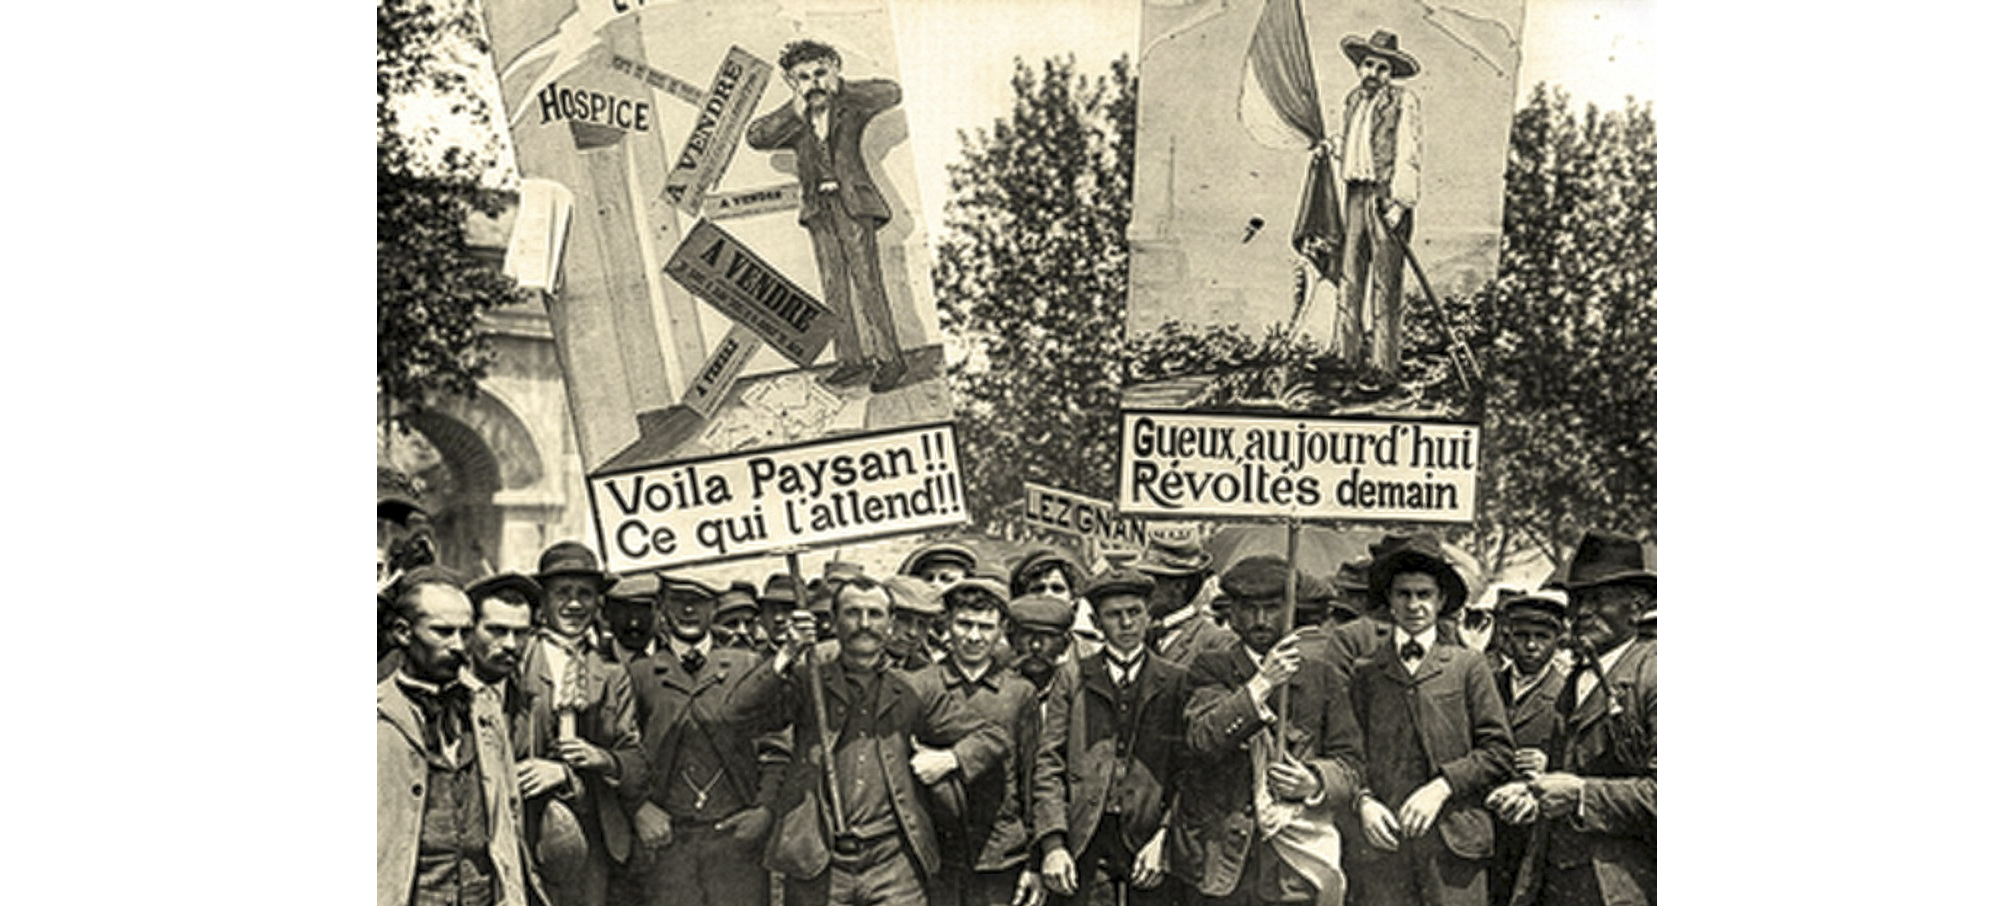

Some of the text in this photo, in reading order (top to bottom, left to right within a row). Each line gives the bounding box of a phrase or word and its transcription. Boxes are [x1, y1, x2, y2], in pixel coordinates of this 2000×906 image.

[538, 82, 649, 131] HOSPICE
[676, 60, 743, 171] VENDRE
[666, 184, 687, 202] A
[700, 237, 726, 267] A
[725, 251, 821, 334] VENDRE
[1134, 417, 1474, 472] Gueux, aujourd'hui
[604, 466, 733, 515] Voila
[1133, 459, 1458, 509] Révoltés demain
[617, 519, 677, 559] Ce
[696, 504, 768, 555] qui
[1026, 490, 1147, 547] LEZGNAN
